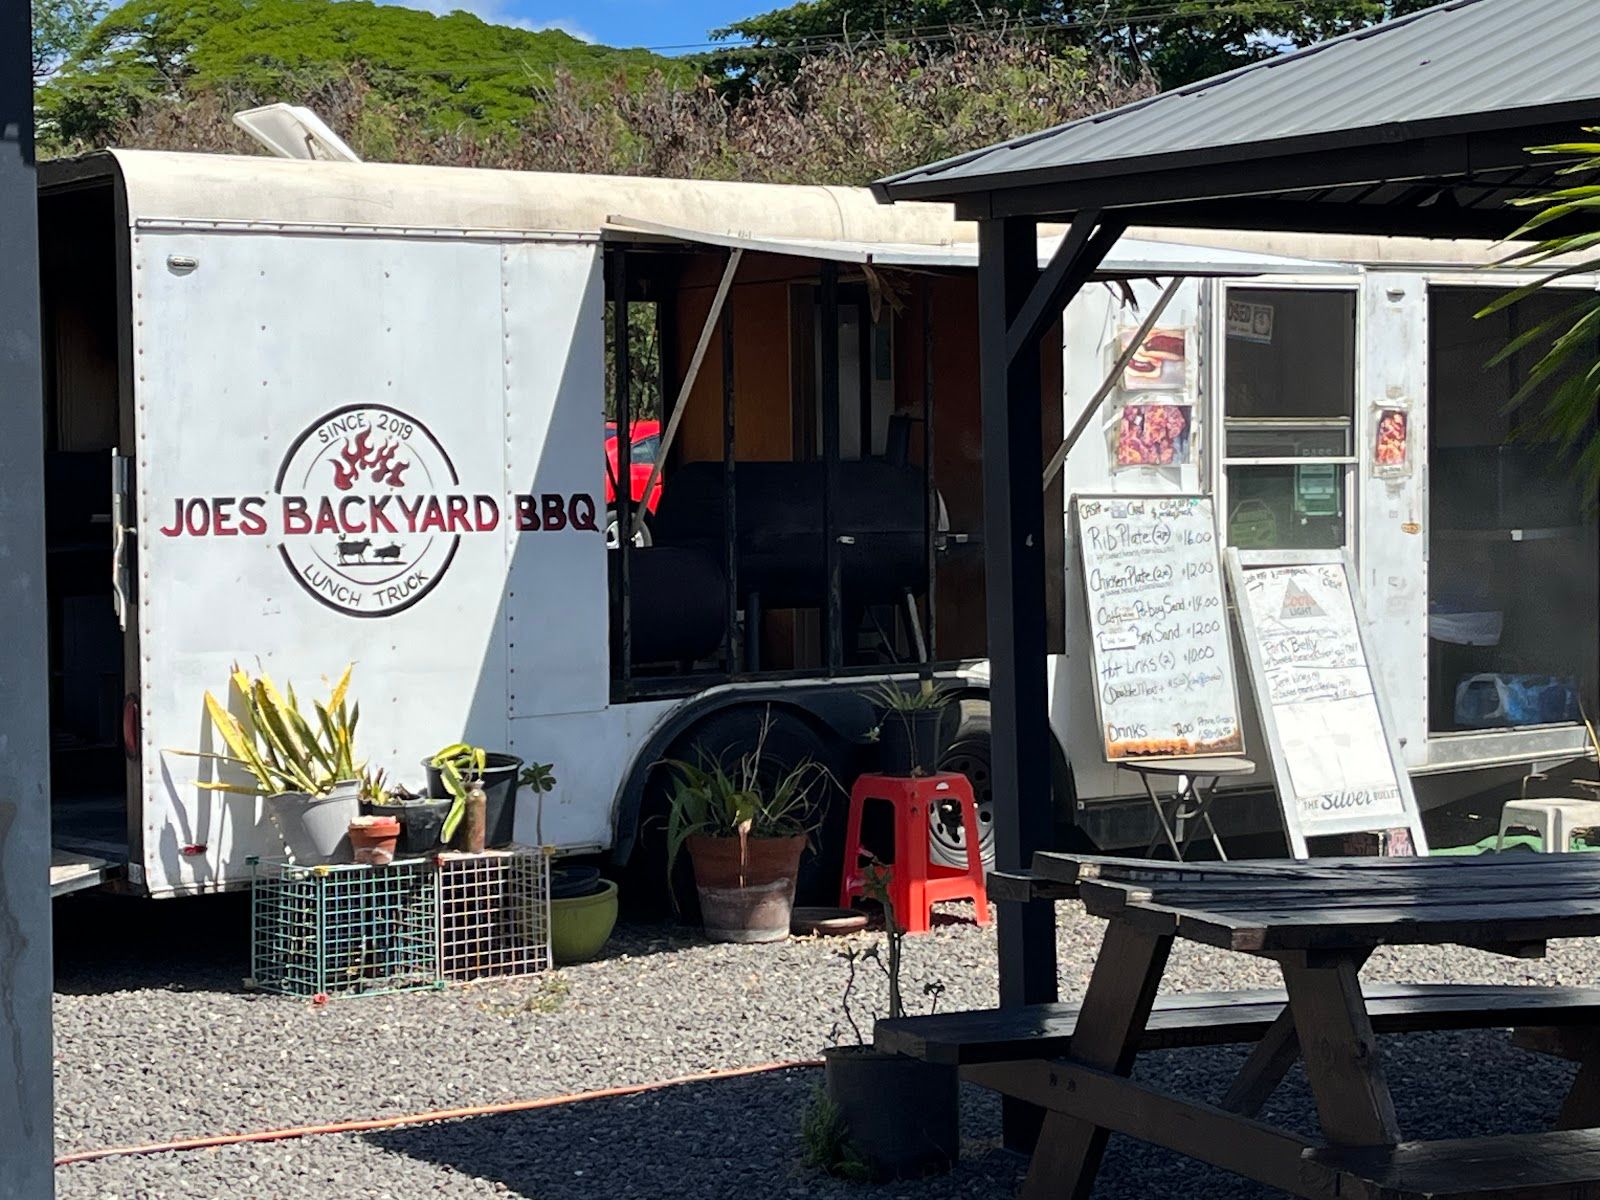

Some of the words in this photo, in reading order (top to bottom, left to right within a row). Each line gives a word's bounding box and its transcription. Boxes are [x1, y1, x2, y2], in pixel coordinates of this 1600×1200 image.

[317, 413, 366, 444] SINCE
[376, 414, 413, 440] 2019
[160, 497, 268, 537] JOES
[283, 494, 499, 535] BACKYARD
[514, 493, 599, 532] BBQ
[1088, 525, 1117, 551] Rib
[303, 564, 362, 606] LUNCH
[373, 570, 429, 606] TRUCK
[1090, 568, 1126, 592] Chicken
[1164, 595, 1185, 614] Sand
[1289, 607, 1313, 616] LIGHT
[1155, 622, 1180, 642] Sand
[1287, 636, 1317, 657] Belly
[1101, 656, 1122, 680] Hot
[1108, 723, 1148, 742] Drinks
[1304, 800, 1319, 811] THE
[1321, 791, 1372, 811] Silver
